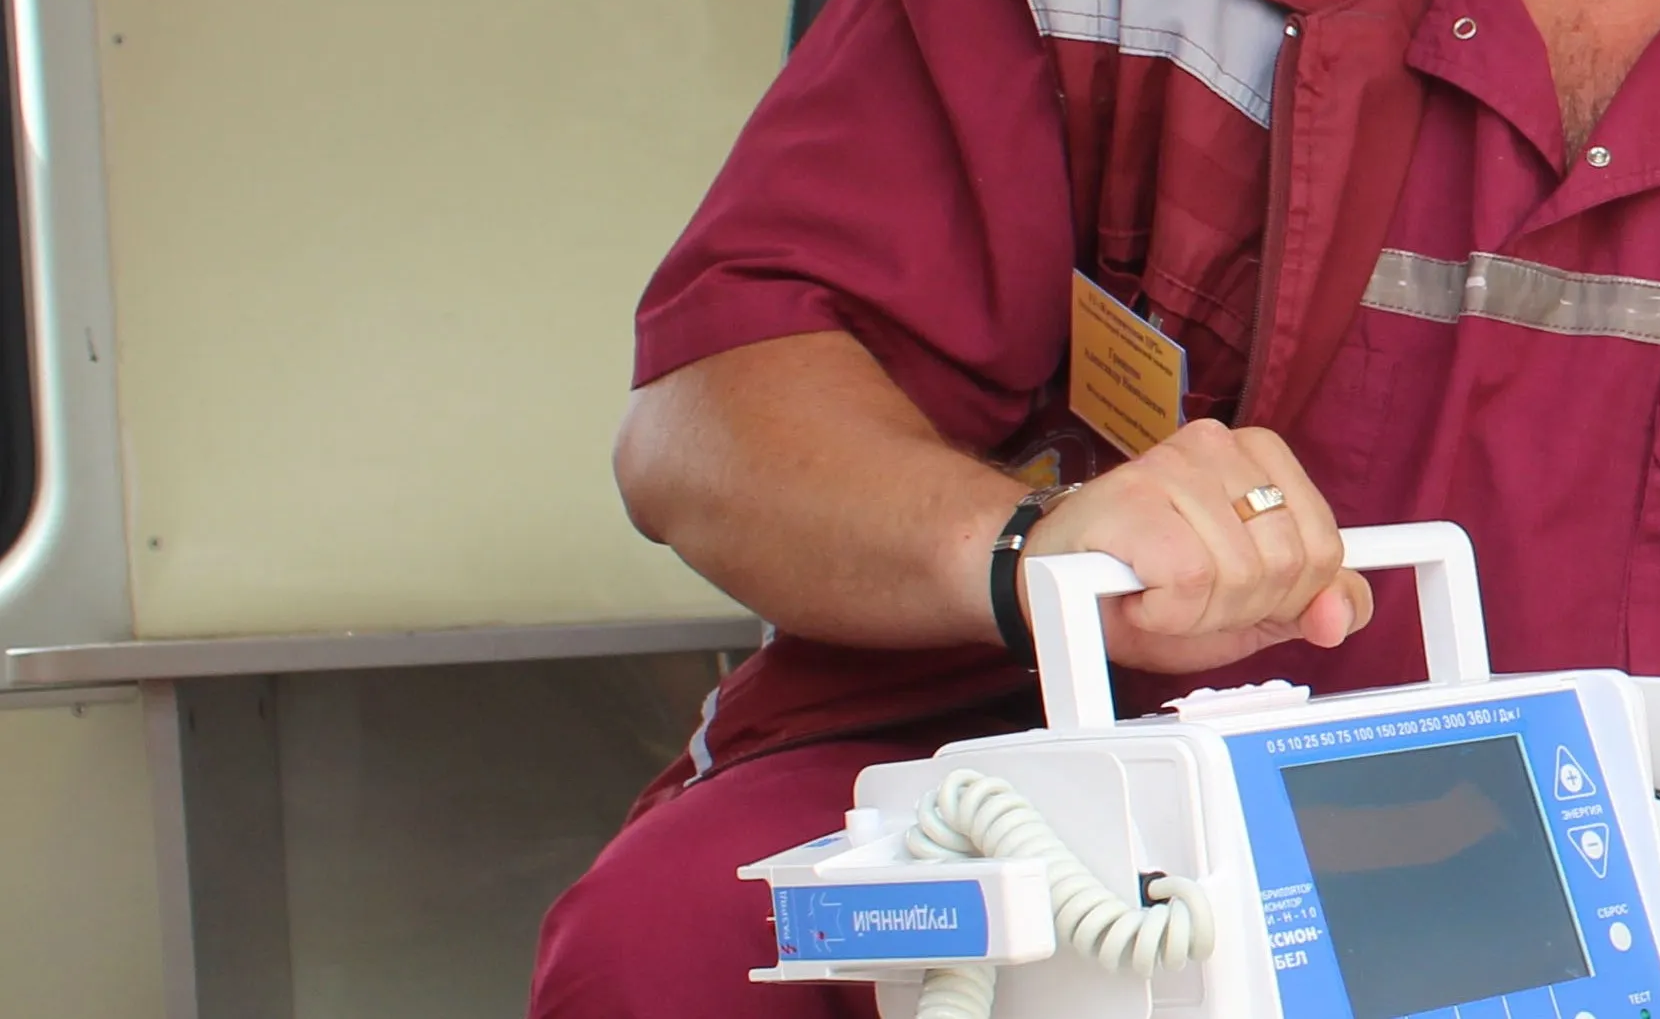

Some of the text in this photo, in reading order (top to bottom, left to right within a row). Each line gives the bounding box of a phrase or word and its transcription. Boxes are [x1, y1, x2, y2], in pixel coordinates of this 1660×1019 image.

[1266, 739, 1276, 754] 0
[1277, 737, 1286, 752] 5
[1288, 735, 1303, 750] 10
[1304, 733, 1319, 749] 25
[1320, 731, 1336, 746] 50
[1336, 729, 1352, 743] 75
[1353, 726, 1375, 741] 100
[1376, 722, 1396, 738] 150
[1397, 720, 1419, 736] 200
[1419, 716, 1441, 733] 250
[1442, 712, 1466, 729] 300
[1467, 708, 1492, 726] 360
[1561, 804, 1604, 821] ЭНЕРГИЯ
[1261, 882, 1314, 901] БРИЛЛЯТОР
[853, 902, 958, 938] ГРУДИННЫЙ
[1596, 903, 1629, 919] СБРОС
[1274, 949, 1309, 971] БЕЛ
[1627, 989, 1651, 1005] ТЕСТ
